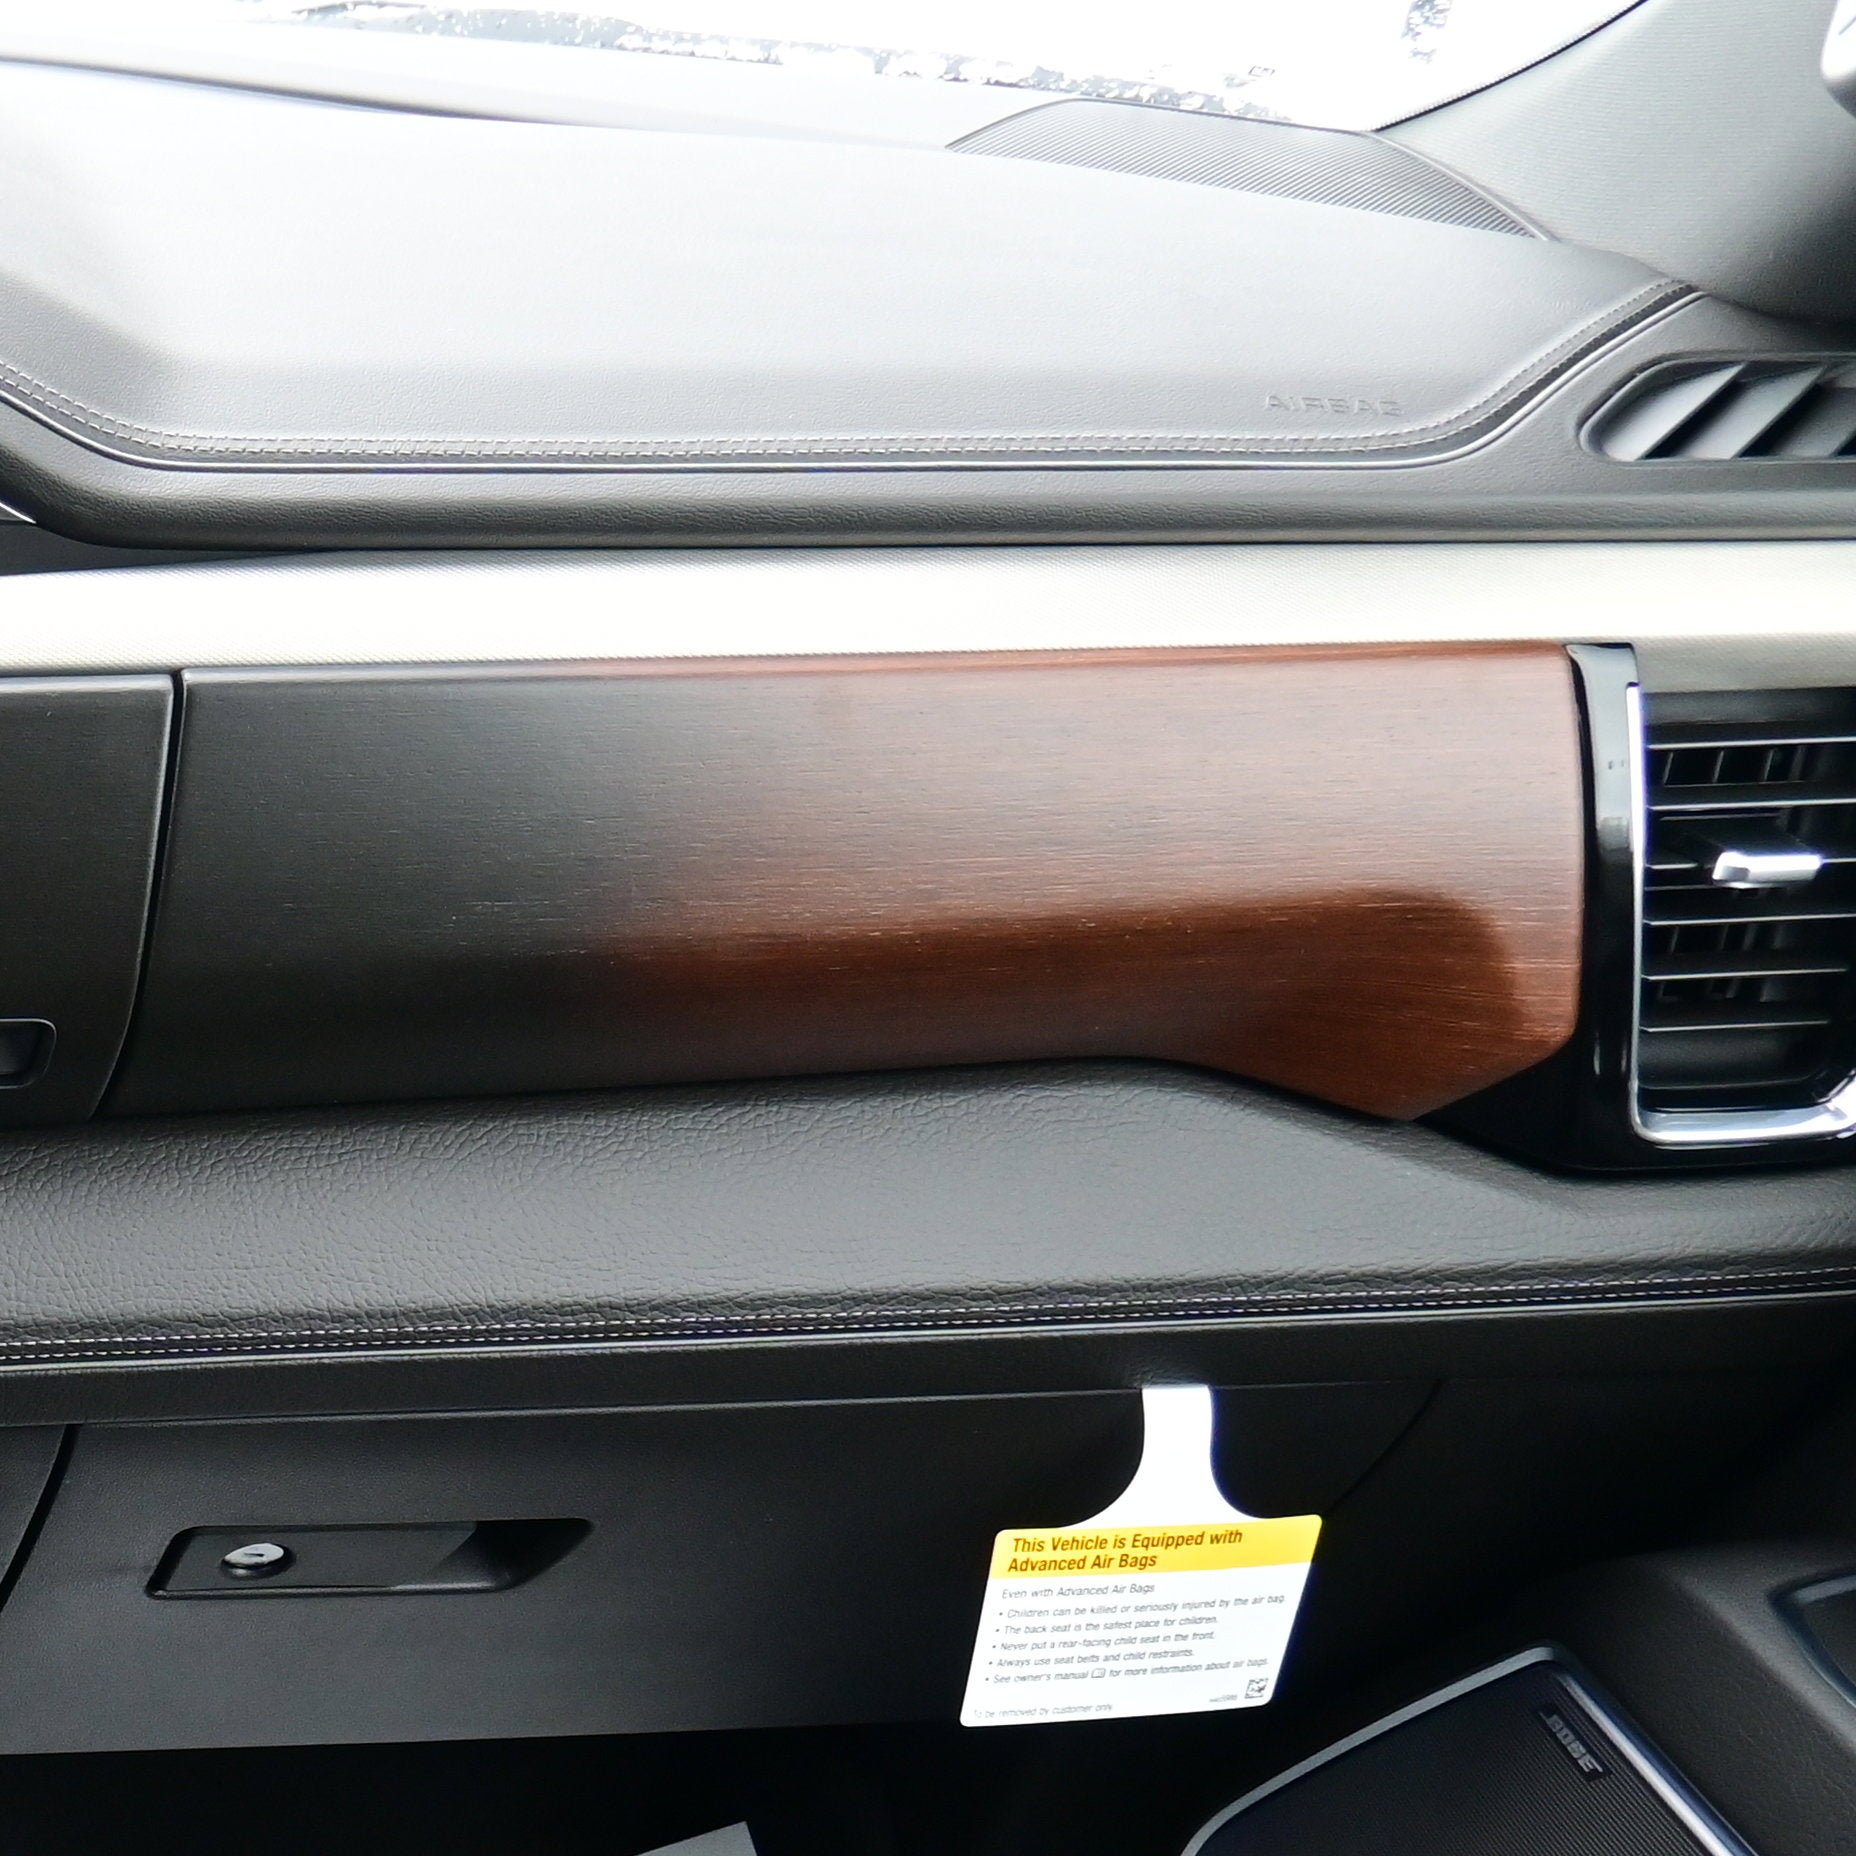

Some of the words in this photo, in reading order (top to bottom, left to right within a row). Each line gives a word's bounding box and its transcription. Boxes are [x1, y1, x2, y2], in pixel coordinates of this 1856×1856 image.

[1265, 395, 1404, 416] AIRBAG
[1013, 1538, 1045, 1553] This
[1052, 1536, 1108, 1552] Vehicle
[1113, 1534, 1126, 1549] is
[1131, 1531, 1204, 1550] Equipped
[1209, 1529, 1243, 1545] with
[1007, 1556, 1086, 1572] Advanced
[1091, 1554, 1115, 1569] Air
[1118, 1553, 1158, 1570] Bags
[1002, 1589, 1027, 1600] Even
[1031, 1588, 1053, 1598] with
[1057, 1586, 1109, 1597] Advanced
[1112, 1585, 1127, 1595] Air
[1130, 1583, 1155, 1596] Bags
[1007, 1608, 1049, 1618] Children
[1052, 1608, 1071, 1617] can
[1074, 1606, 1087, 1616] be
[1134, 1602, 1178, 1615] seriously
